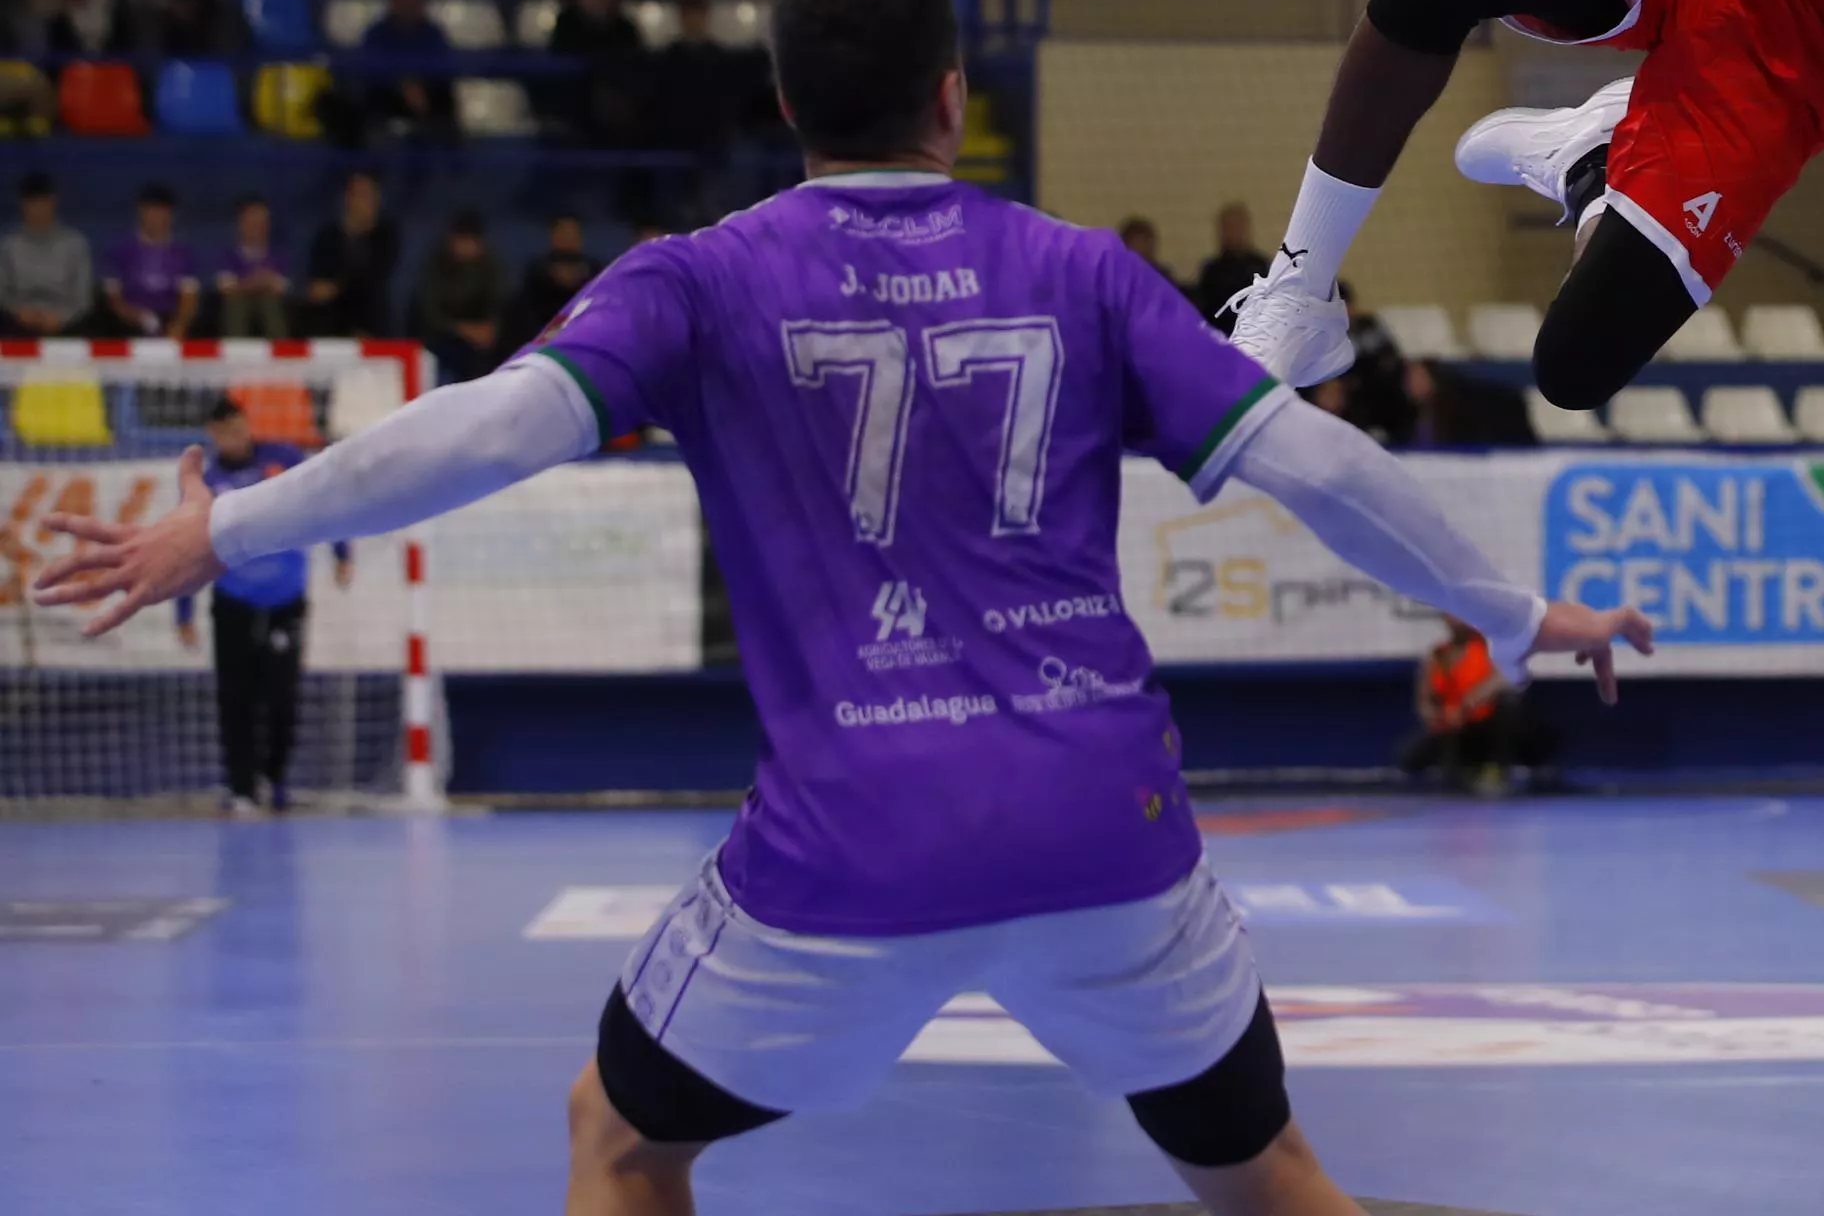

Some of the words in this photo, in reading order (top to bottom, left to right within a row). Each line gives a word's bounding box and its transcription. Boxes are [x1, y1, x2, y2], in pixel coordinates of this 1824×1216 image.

[840, 264, 866, 296] J.
[874, 268, 980, 306] JODAR
[781, 316, 1064, 547] 77
[1567, 477, 1766, 552] SANI
[835, 694, 997, 726] Guadalagua
